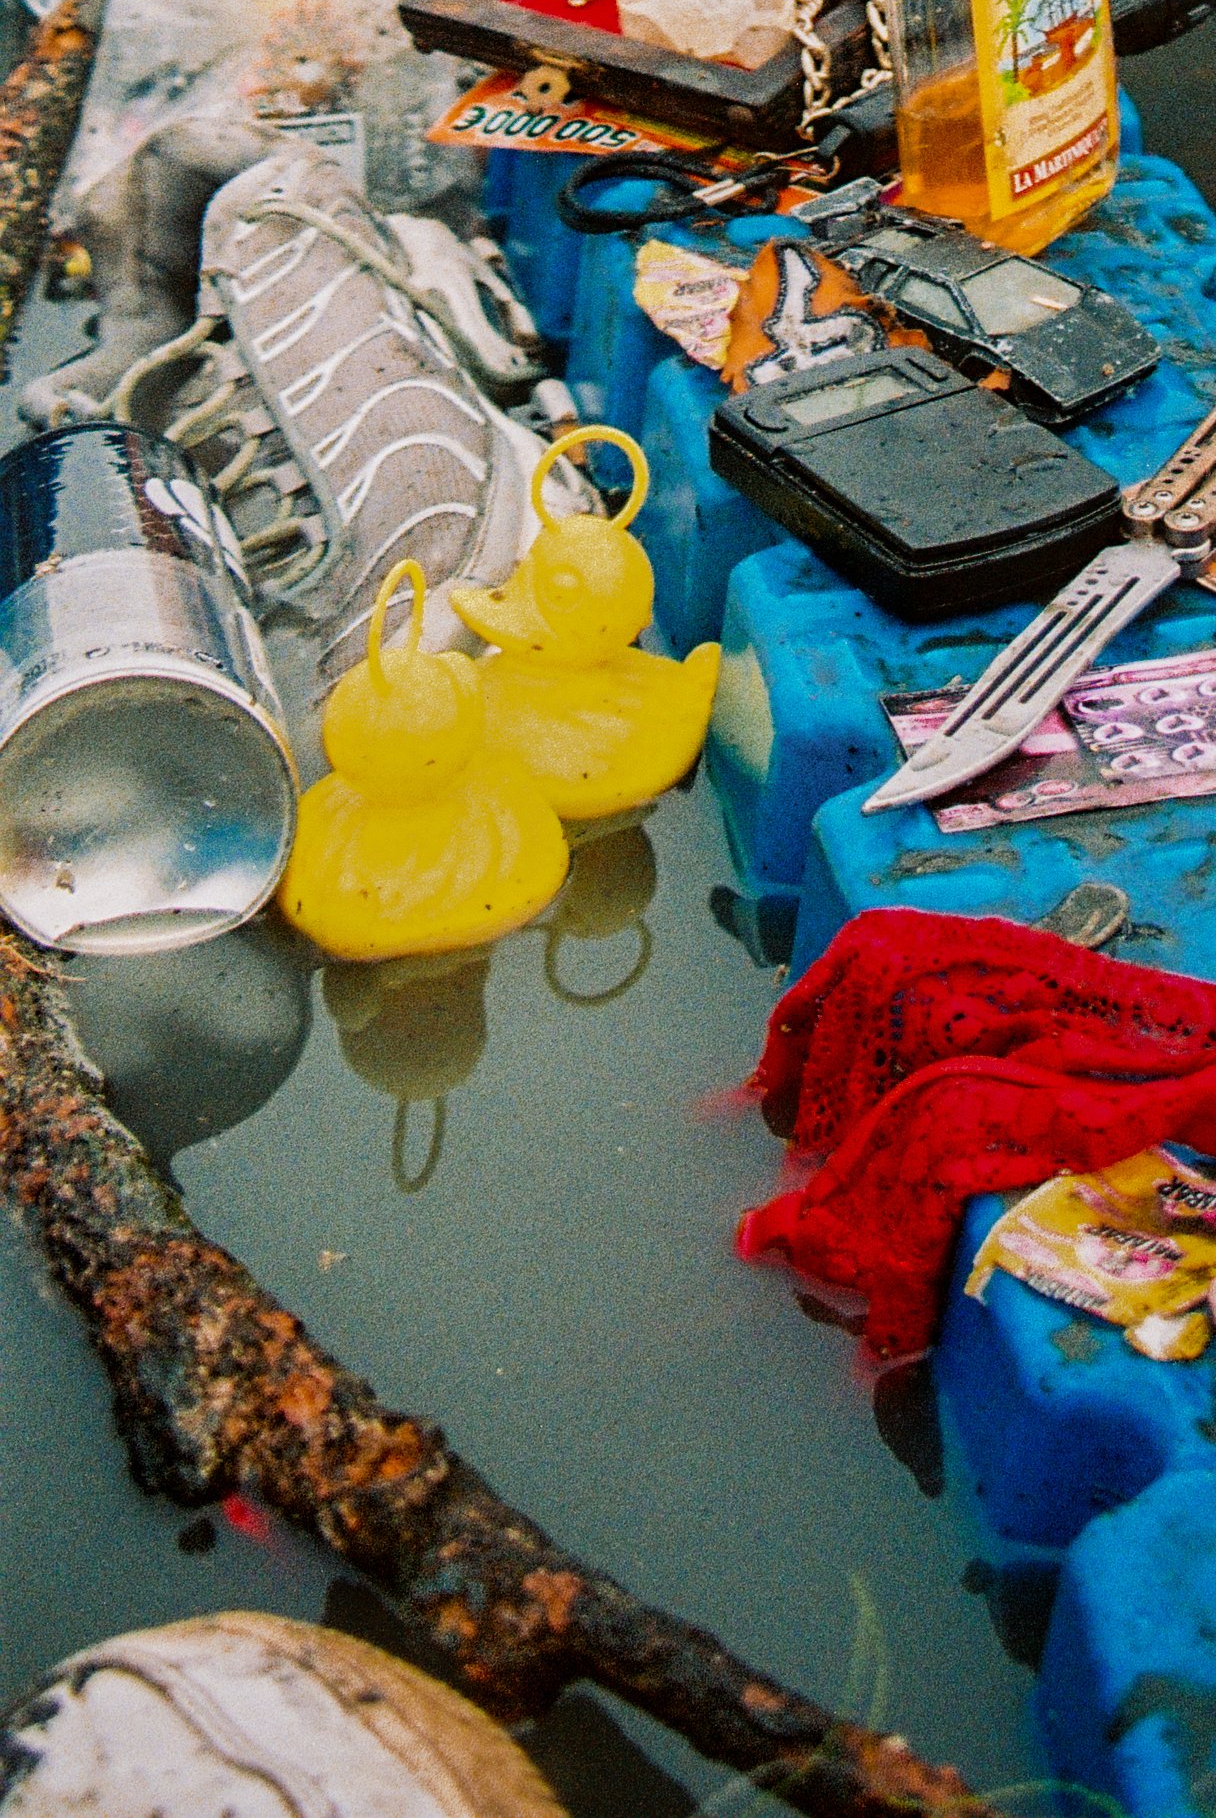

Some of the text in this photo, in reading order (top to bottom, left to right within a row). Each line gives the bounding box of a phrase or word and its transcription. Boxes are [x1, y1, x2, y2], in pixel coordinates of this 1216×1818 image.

[451, 106, 637, 148] 500 000€
[1013, 171, 1034, 194] LA
[1080, 1224, 1184, 1262] MALABAR
